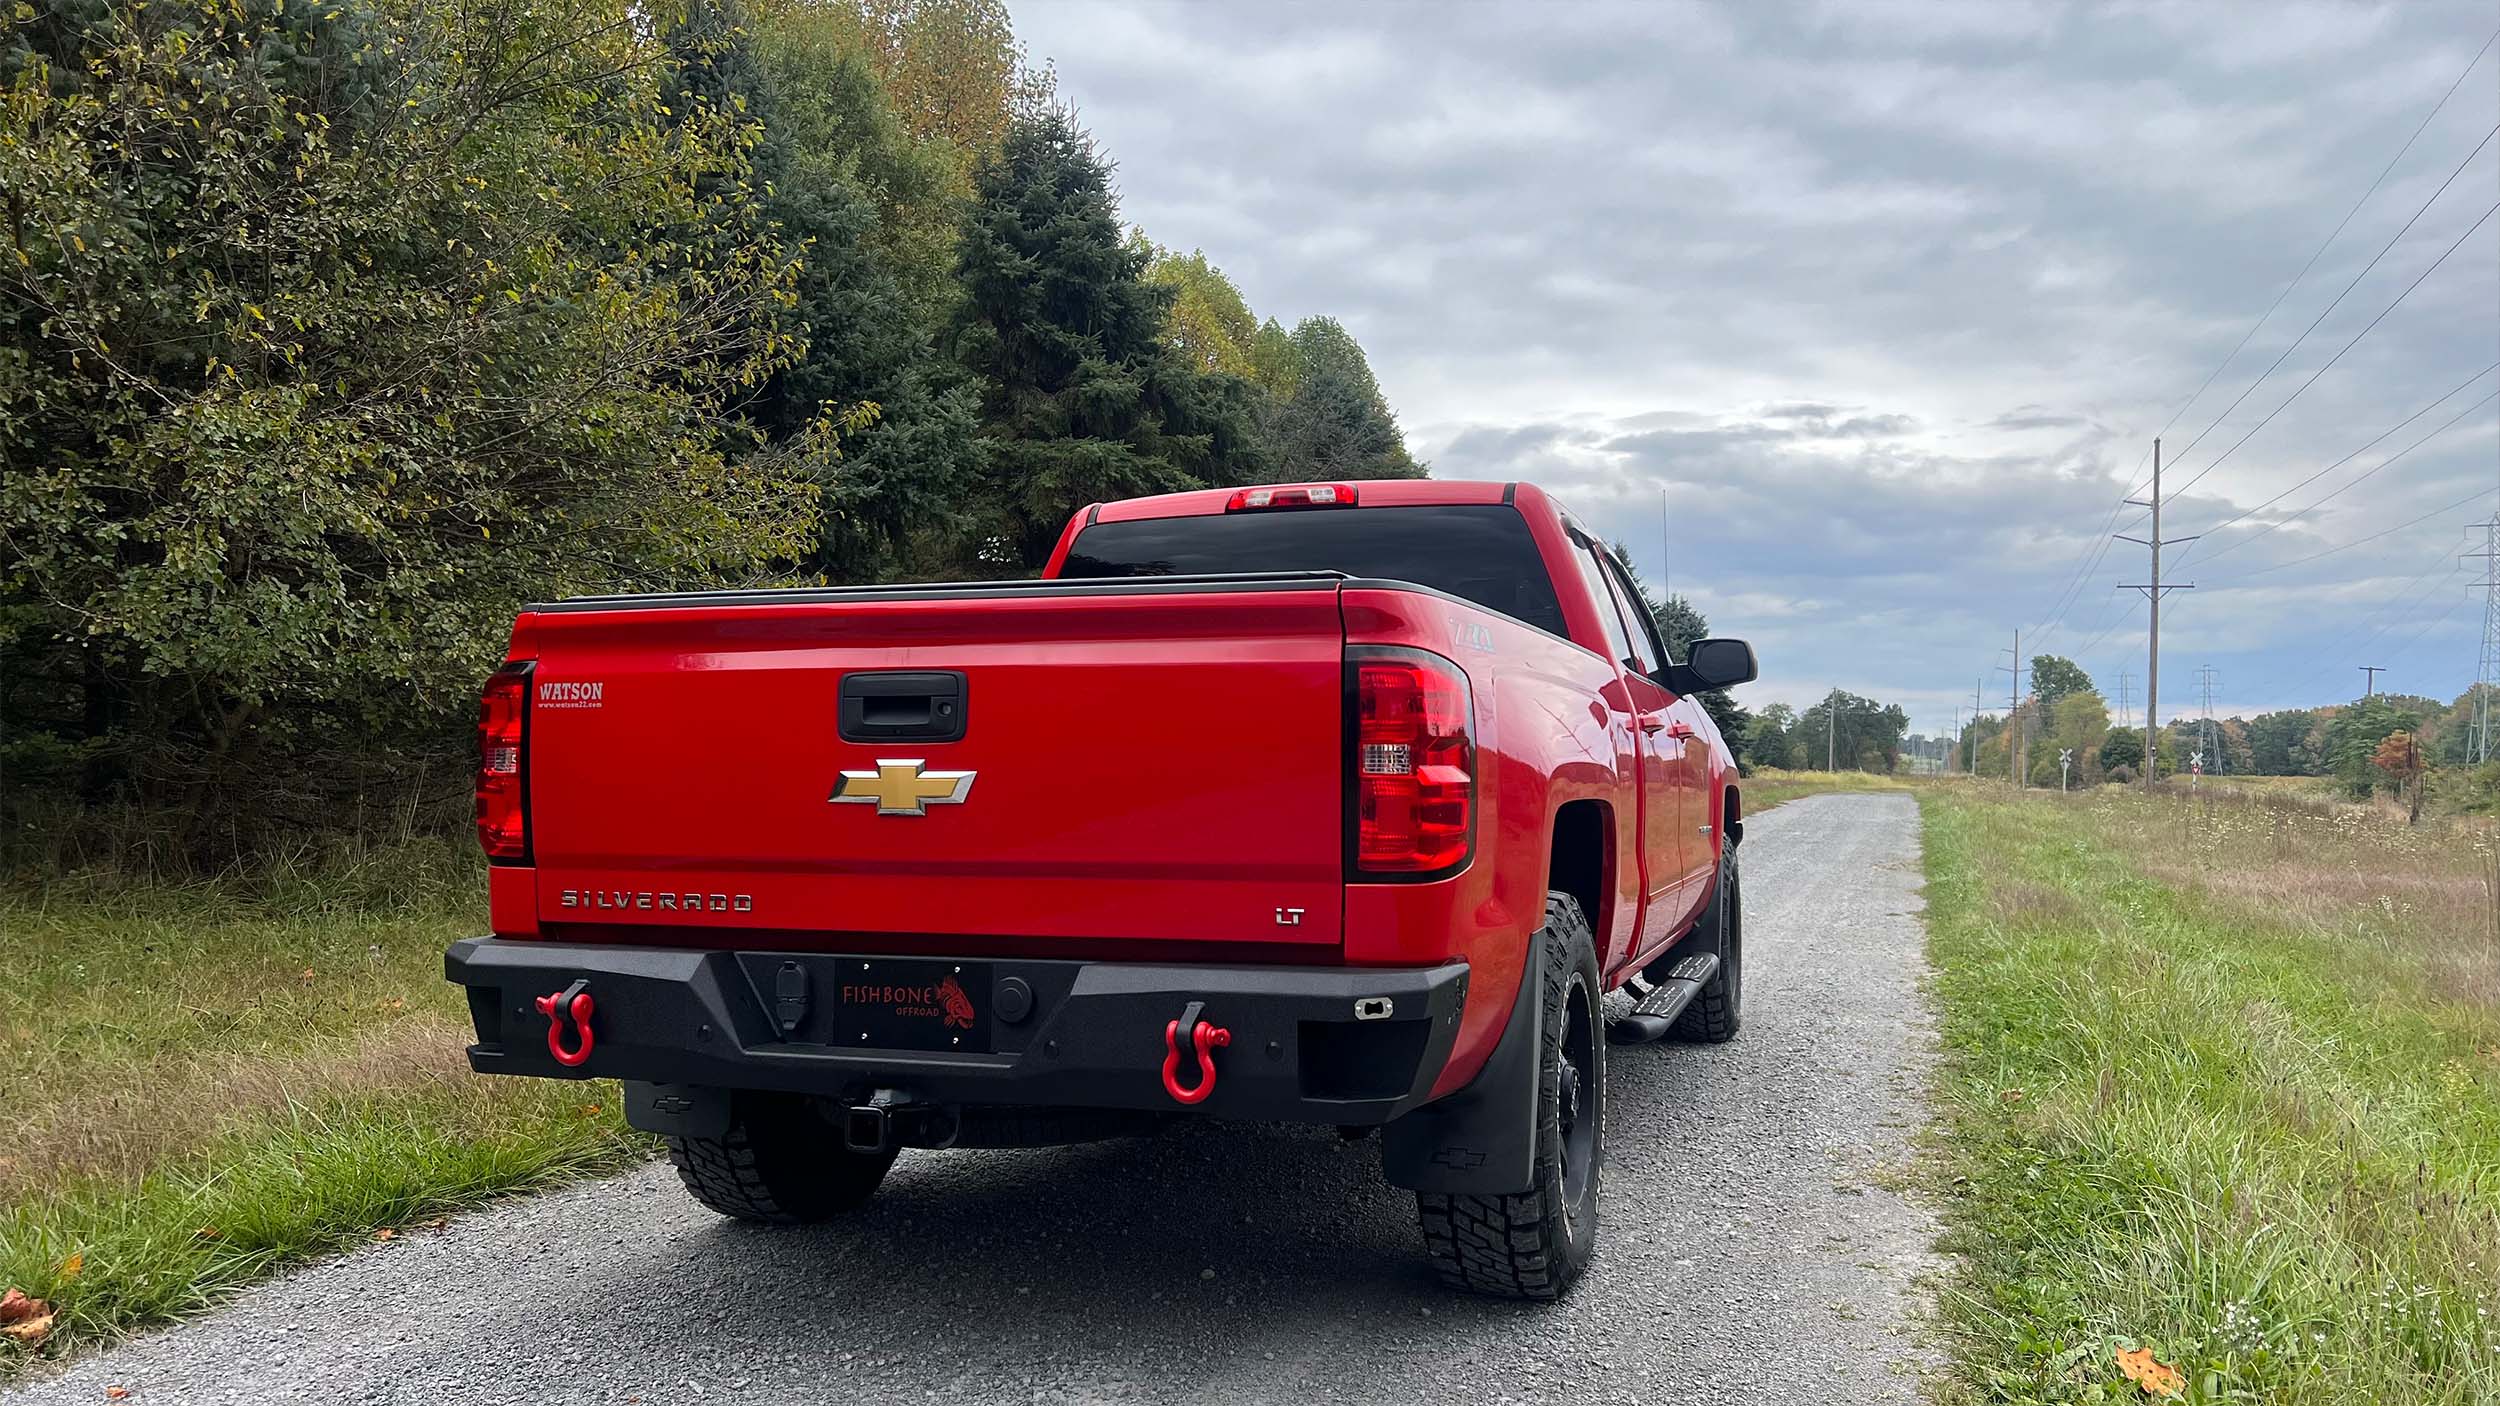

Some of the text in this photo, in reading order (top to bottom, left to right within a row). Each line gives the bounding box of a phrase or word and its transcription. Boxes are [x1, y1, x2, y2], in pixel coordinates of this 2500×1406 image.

[540, 682, 603, 700] WATSON
[560, 890, 752, 911] SILVERADO
[1276, 907, 1305, 925] LT
[842, 985, 933, 1004] FISHBONE
[896, 1007, 940, 1017] OFFROAD
